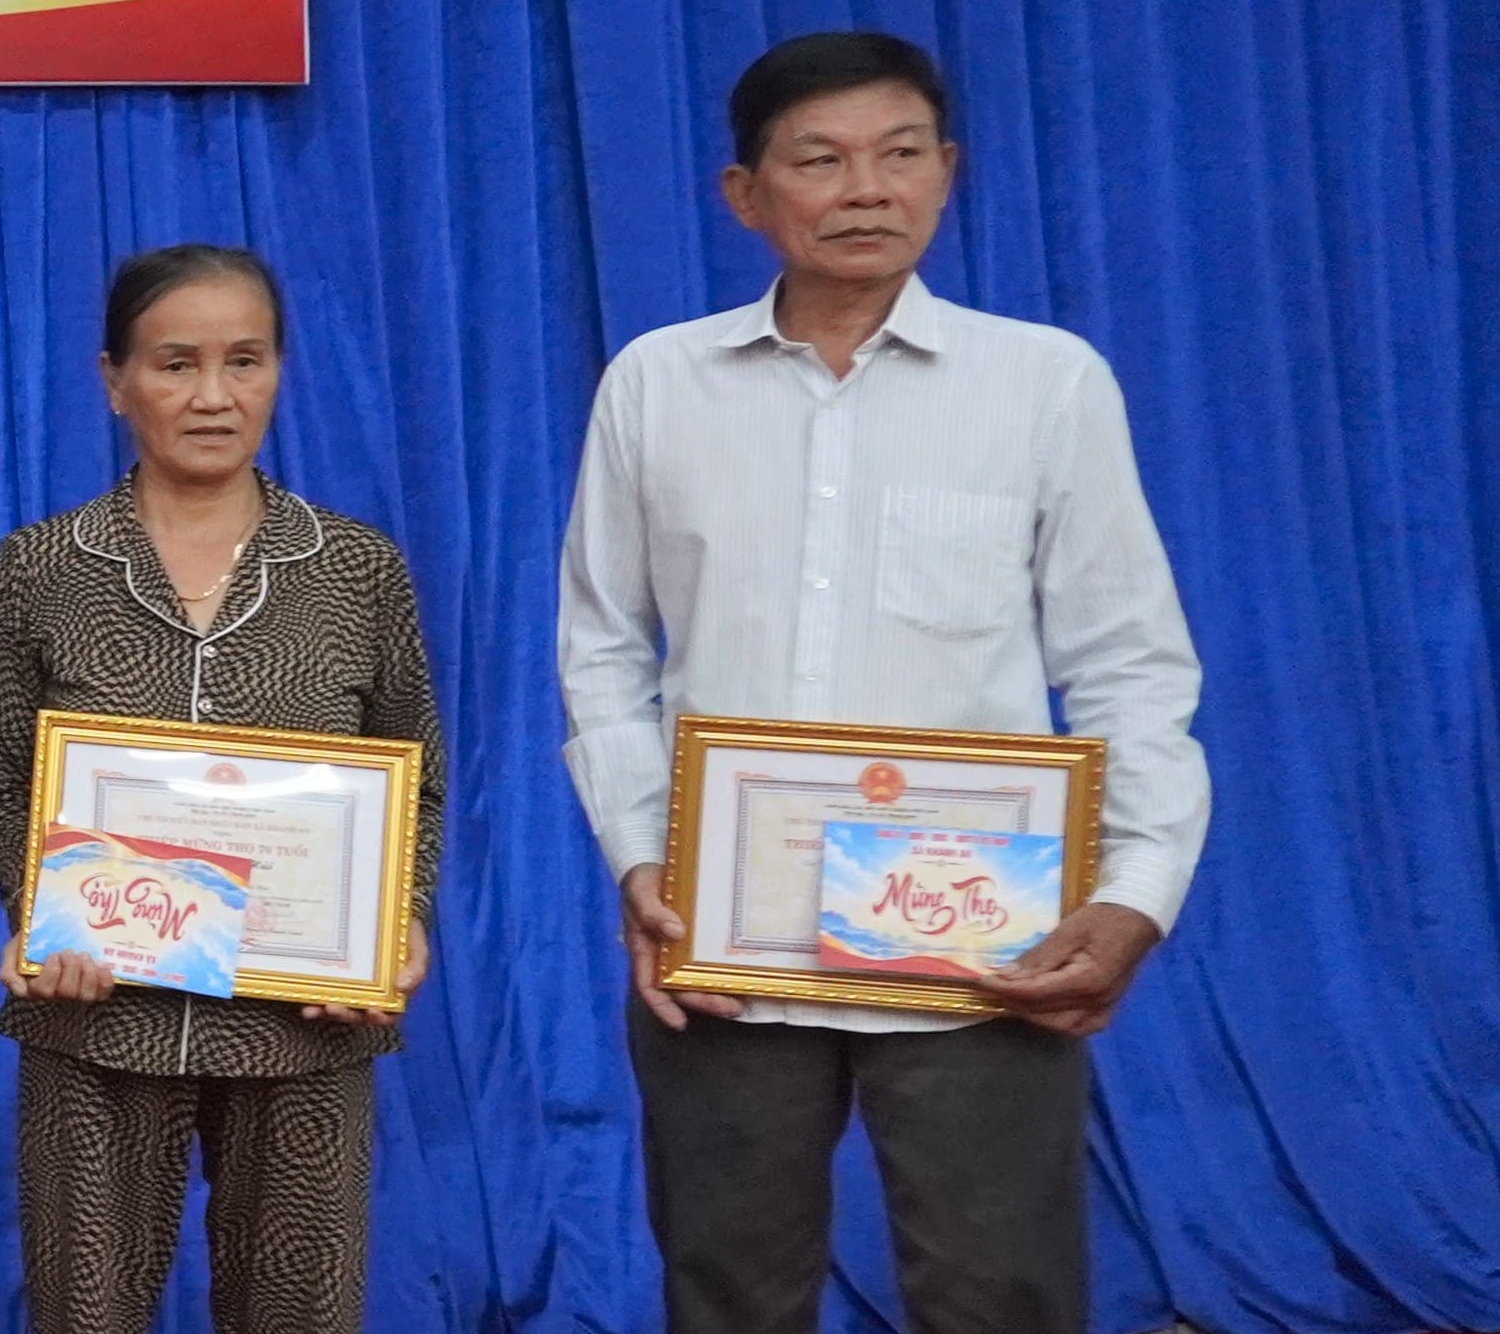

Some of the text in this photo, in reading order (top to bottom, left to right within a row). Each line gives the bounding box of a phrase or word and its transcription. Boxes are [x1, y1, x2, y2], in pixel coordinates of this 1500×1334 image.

[80, 873, 126, 930] Thọ
[125, 877, 198, 942] Mừng
[872, 871, 1009, 936] Mừng Thọ
